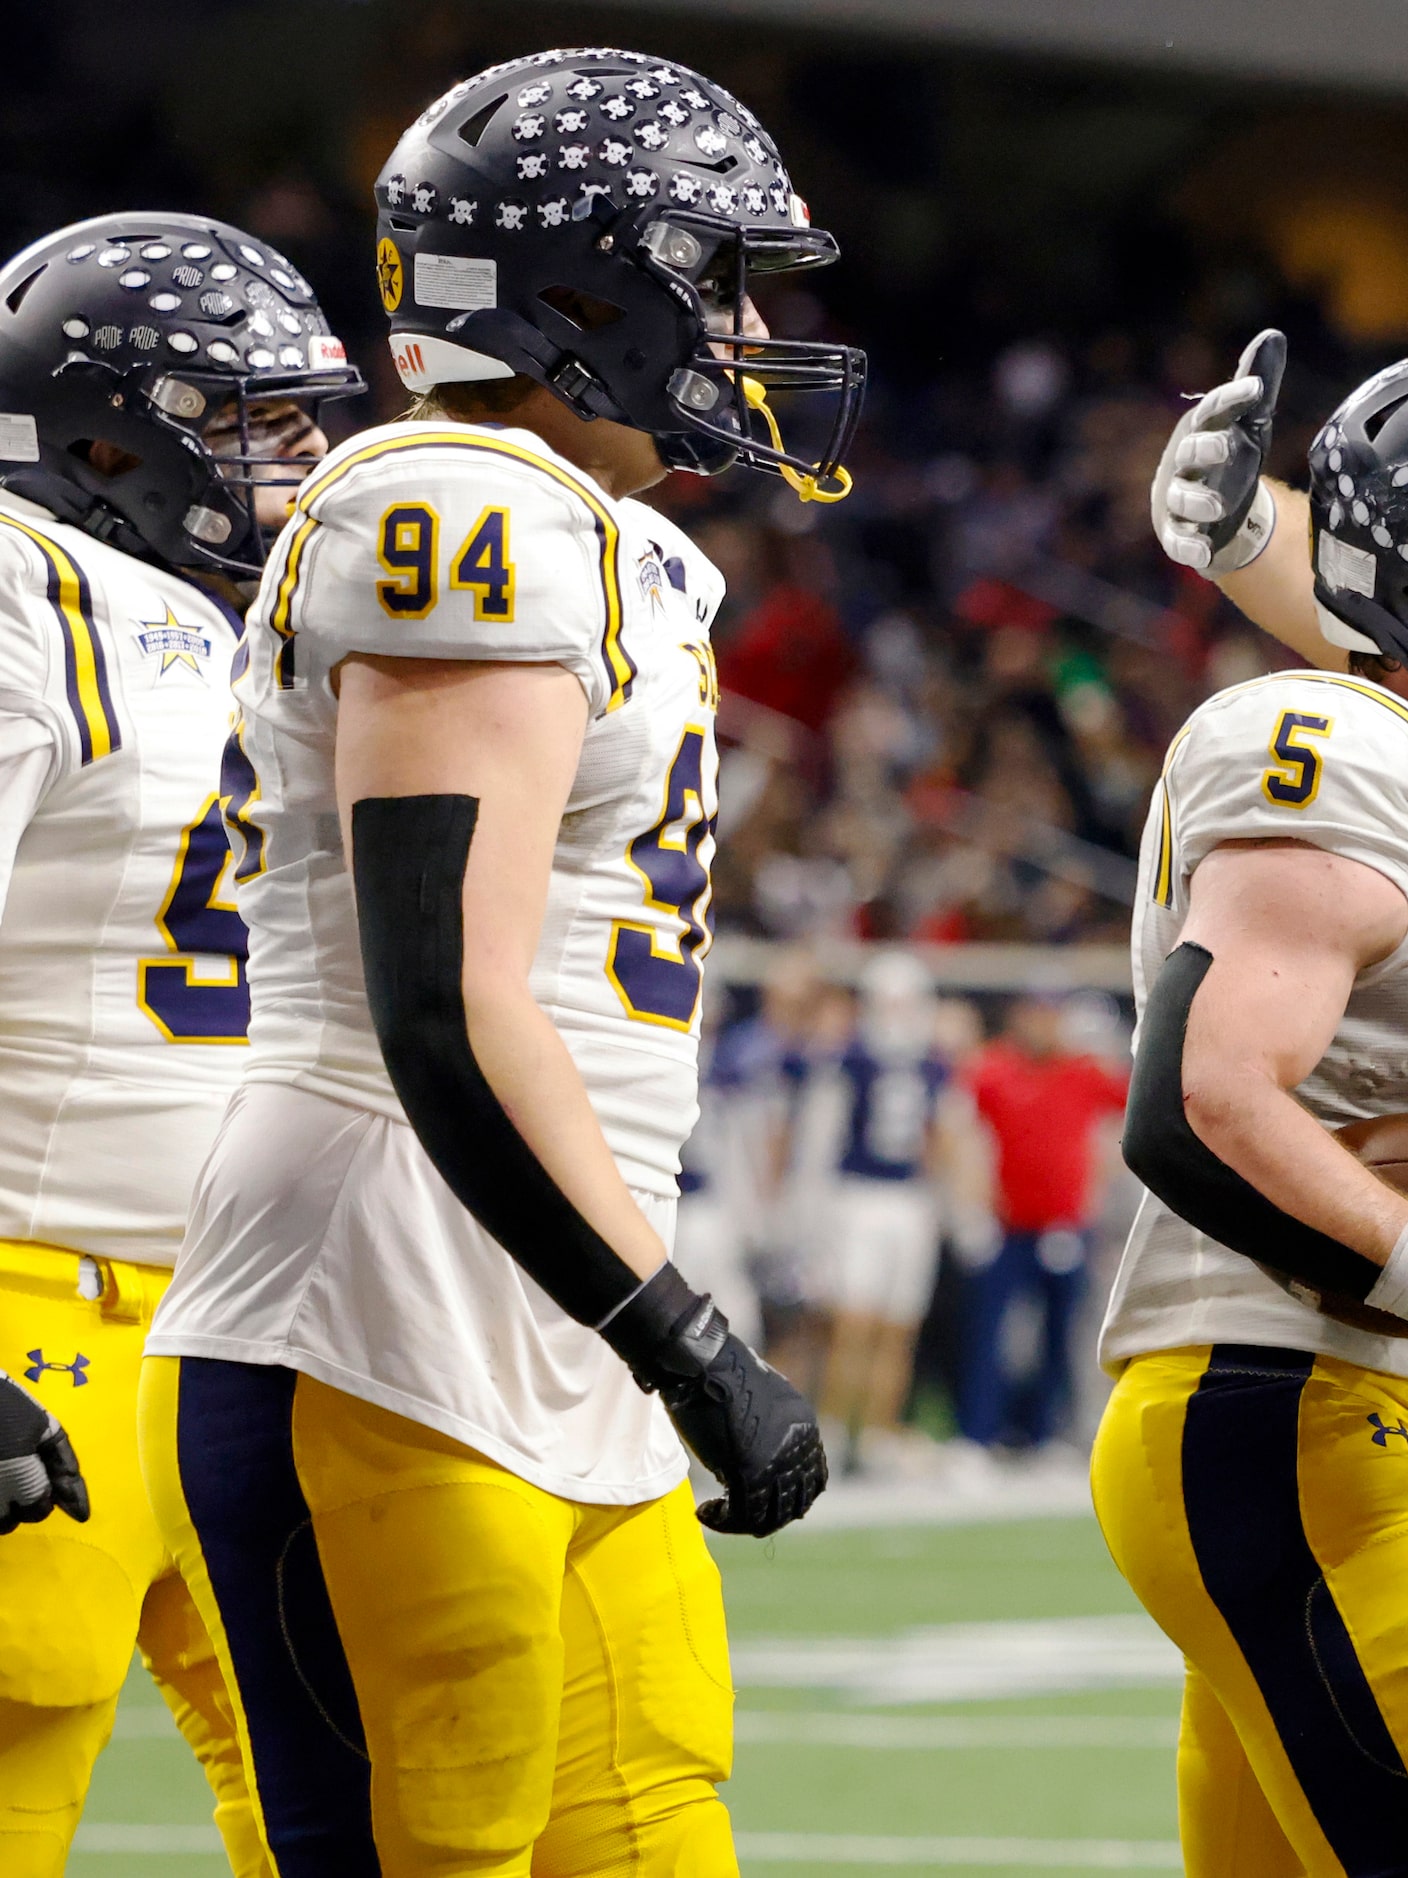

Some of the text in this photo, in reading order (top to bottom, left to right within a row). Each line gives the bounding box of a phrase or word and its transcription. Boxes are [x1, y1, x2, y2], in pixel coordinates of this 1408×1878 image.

[172, 264, 204, 288] PRIDE
[94, 325, 123, 351] PRIDE
[128, 325, 160, 351] PRIDE
[376, 501, 515, 623] 94
[1261, 708, 1336, 810] 5
[604, 722, 719, 1034] 9
